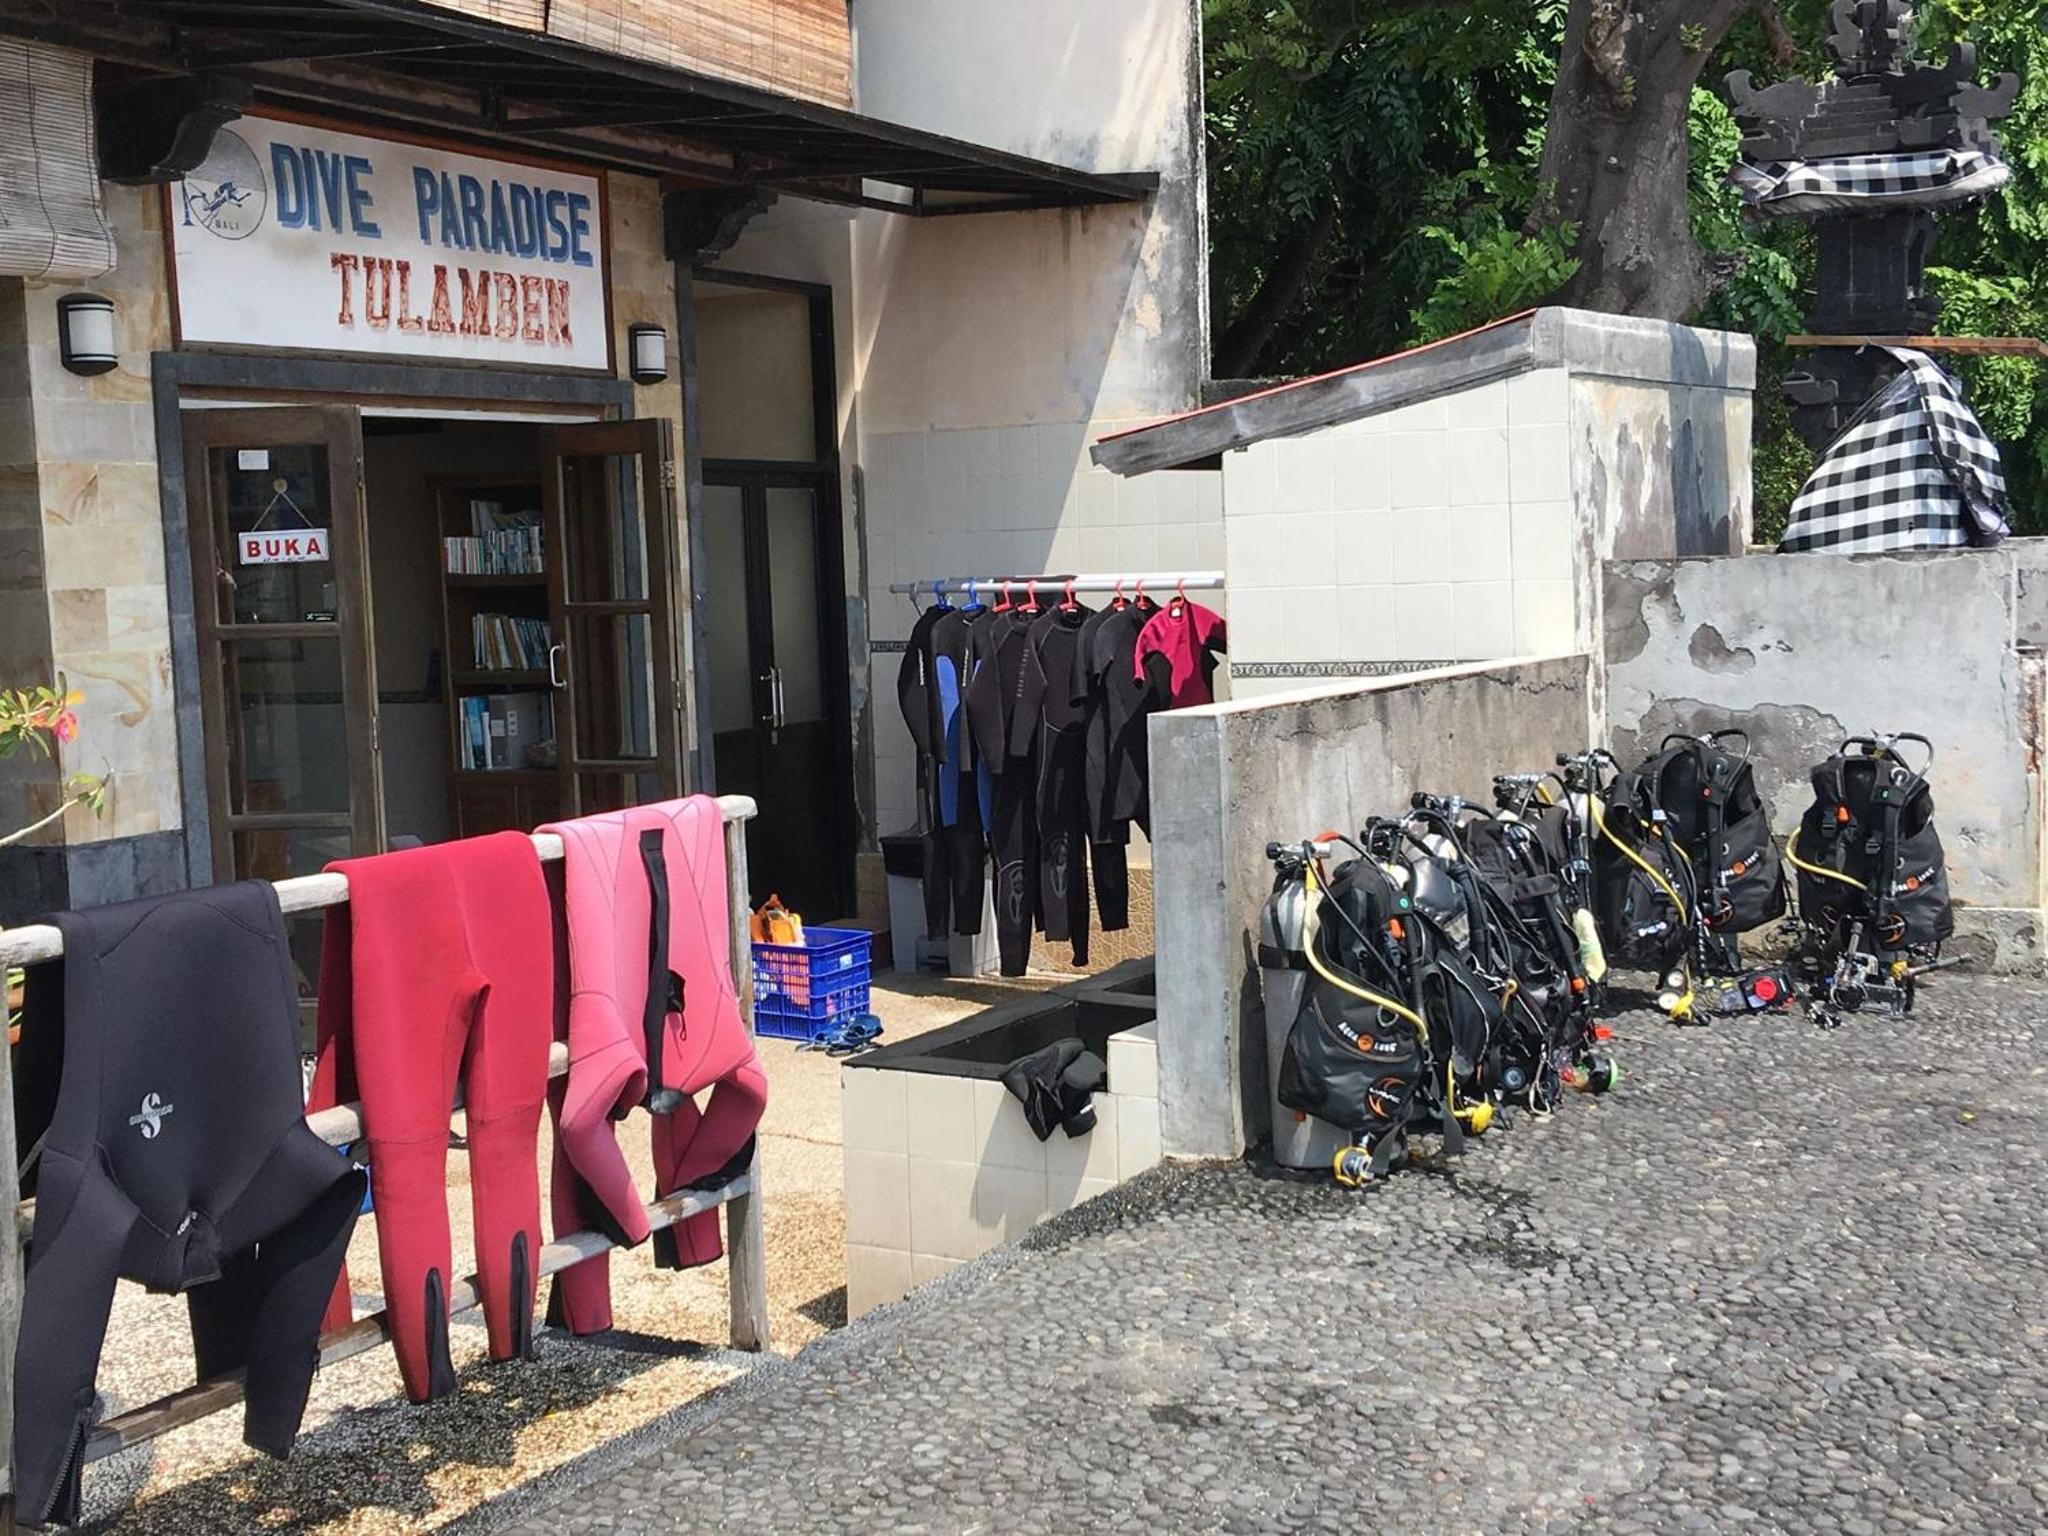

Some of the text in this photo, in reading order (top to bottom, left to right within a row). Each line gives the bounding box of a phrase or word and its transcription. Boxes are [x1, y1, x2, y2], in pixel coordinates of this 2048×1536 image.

[270, 142, 593, 267] DIVE PARADISE
[330, 252, 573, 346] TULAMBEN
[246, 537, 322, 558] BUKA
